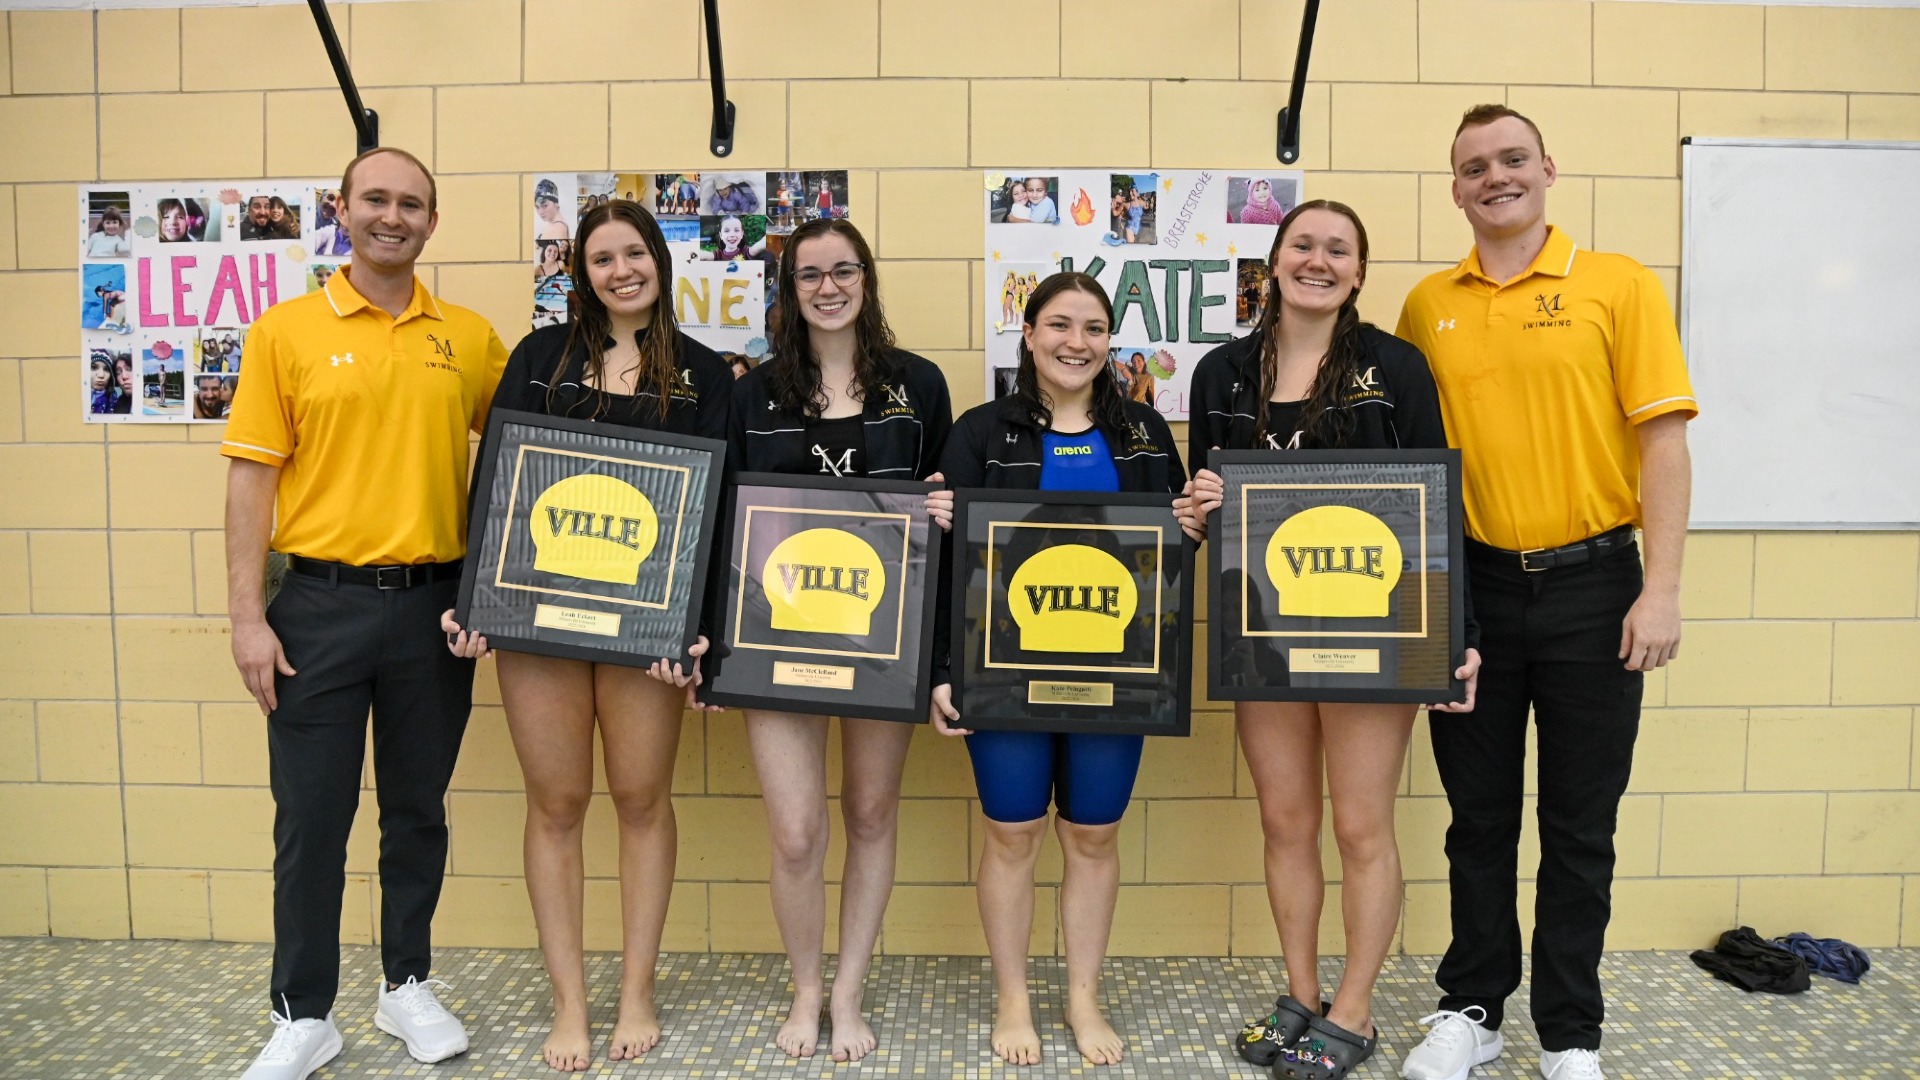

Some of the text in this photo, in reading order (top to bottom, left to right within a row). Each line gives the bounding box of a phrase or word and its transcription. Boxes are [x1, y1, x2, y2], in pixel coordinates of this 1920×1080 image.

[1164, 171, 1212, 249] BREASTSTROKE
[138, 252, 278, 327] LEAH
[1061, 255, 1233, 343] ATE
[1522, 319, 1571, 330] SWIMMING
[425, 361, 463, 374] SWIMMING
[1344, 390, 1385, 401] WIMMING
[1053, 445, 1093, 456] arena
[545, 506, 641, 551] VILLE
[1281, 545, 1385, 581] VILLE
[777, 562, 870, 602] VILLE
[561, 610, 575, 618] Leah
[1024, 584, 1120, 619] VILLE
